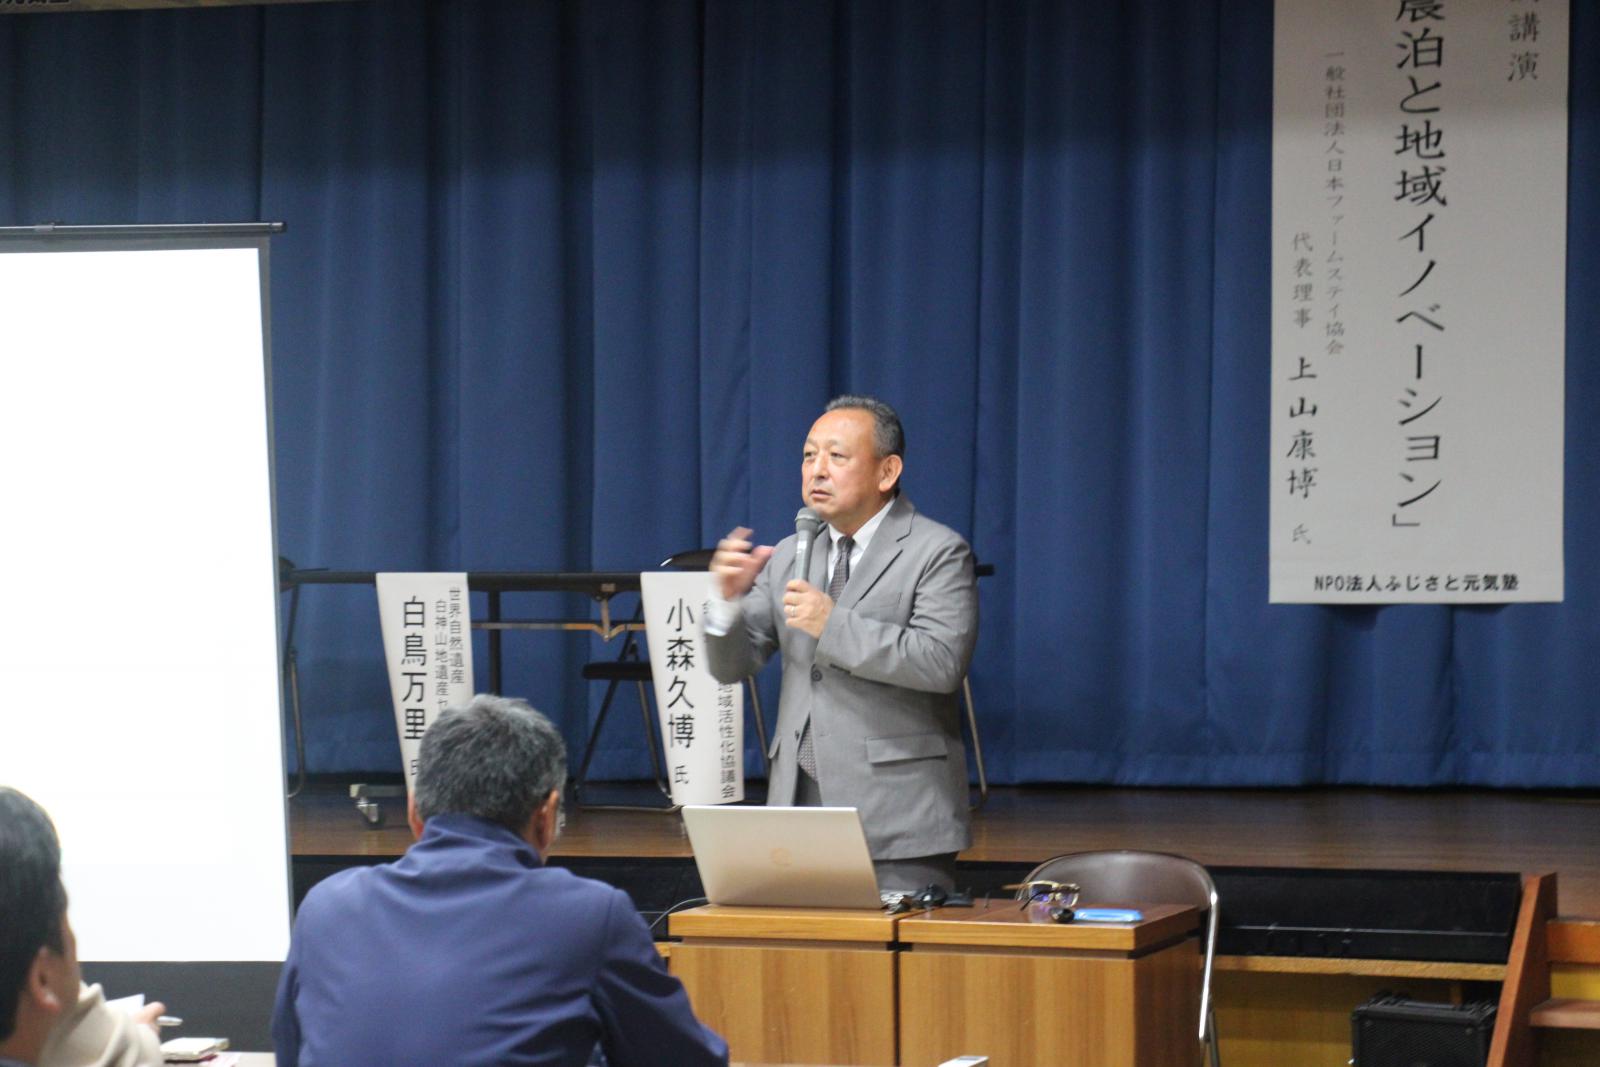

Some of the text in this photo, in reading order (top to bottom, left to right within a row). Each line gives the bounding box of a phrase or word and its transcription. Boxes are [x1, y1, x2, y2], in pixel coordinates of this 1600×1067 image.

[1506, 0, 1541, 82] 講演
[1286, 232, 1318, 545] 代表理事 上山康博 氏
[448, 586, 465, 684] 世界自然遺産
[1314, 573, 1520, 593] NPO法人ふじさと元気塾
[401, 595, 427, 740] 白鳥万里
[666, 597, 695, 785] 小森久博 氏
